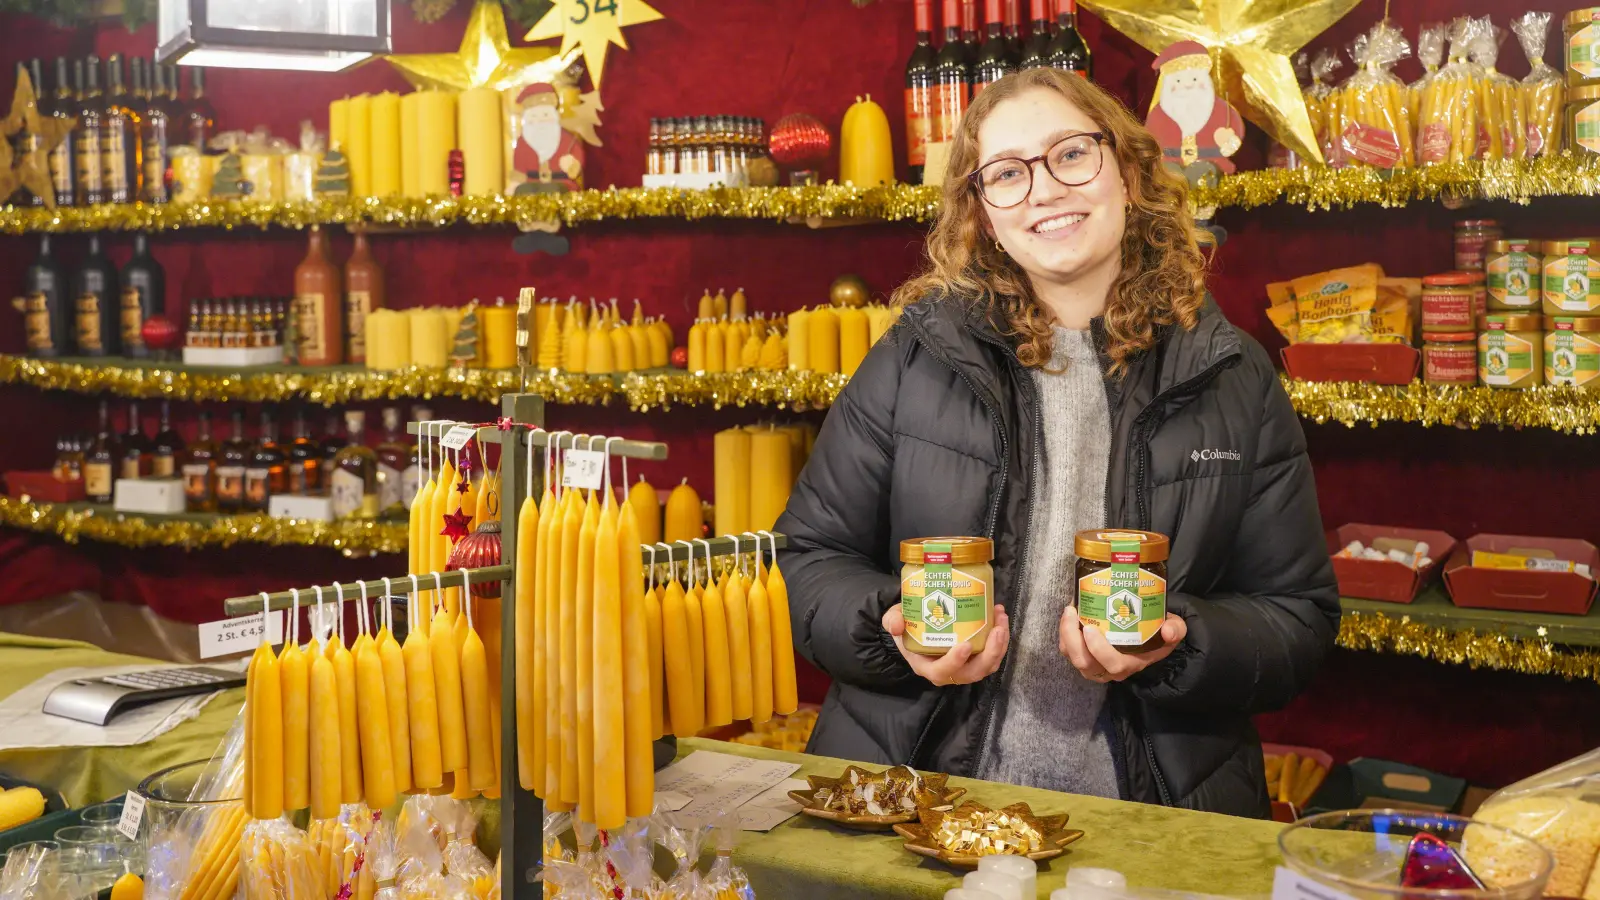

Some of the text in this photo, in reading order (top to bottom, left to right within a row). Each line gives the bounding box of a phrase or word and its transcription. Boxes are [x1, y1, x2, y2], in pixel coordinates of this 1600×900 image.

[1313, 295, 1352, 310] Honig
[1301, 305, 1361, 320] Bonbons
[1201, 448, 1241, 460] Columbia
[924, 571, 952, 580] ECHTER
[1111, 571, 1139, 579] ECHTER
[947, 580, 972, 588] HONIG
[1092, 578, 1156, 588] DEUTSCHER HONIG
[217, 626, 266, 642] 2 St. € 4,5
